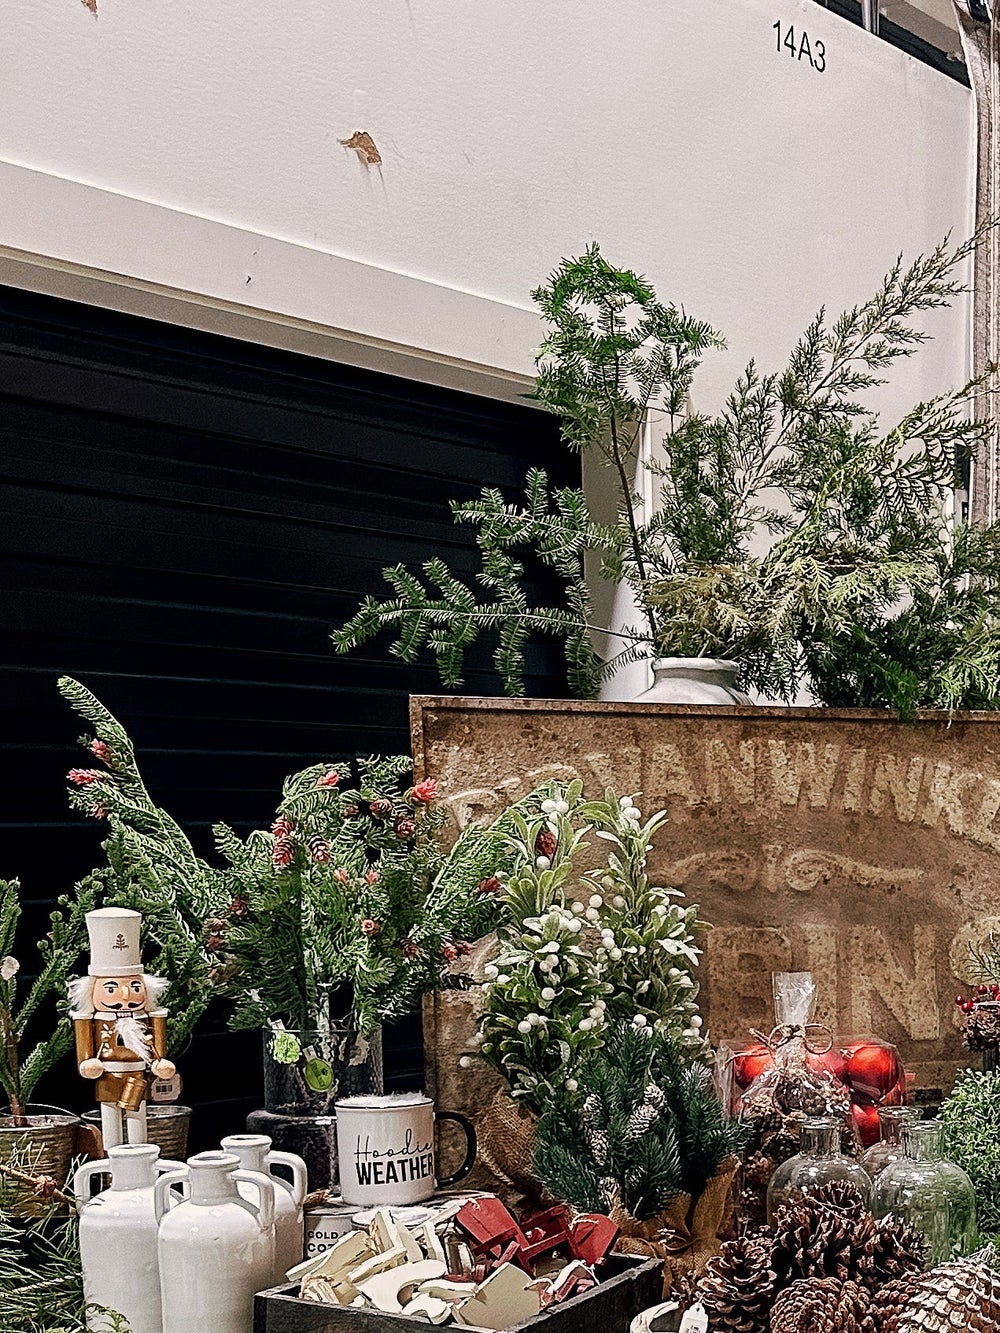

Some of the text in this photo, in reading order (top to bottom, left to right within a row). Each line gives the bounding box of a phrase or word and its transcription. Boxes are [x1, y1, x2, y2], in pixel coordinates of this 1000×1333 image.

[773, 20, 826, 73] 14A3
[354, 1128, 433, 1164] Hoodie
[356, 1153, 434, 1186] WEATHER
[307, 1230, 339, 1240] COLD
